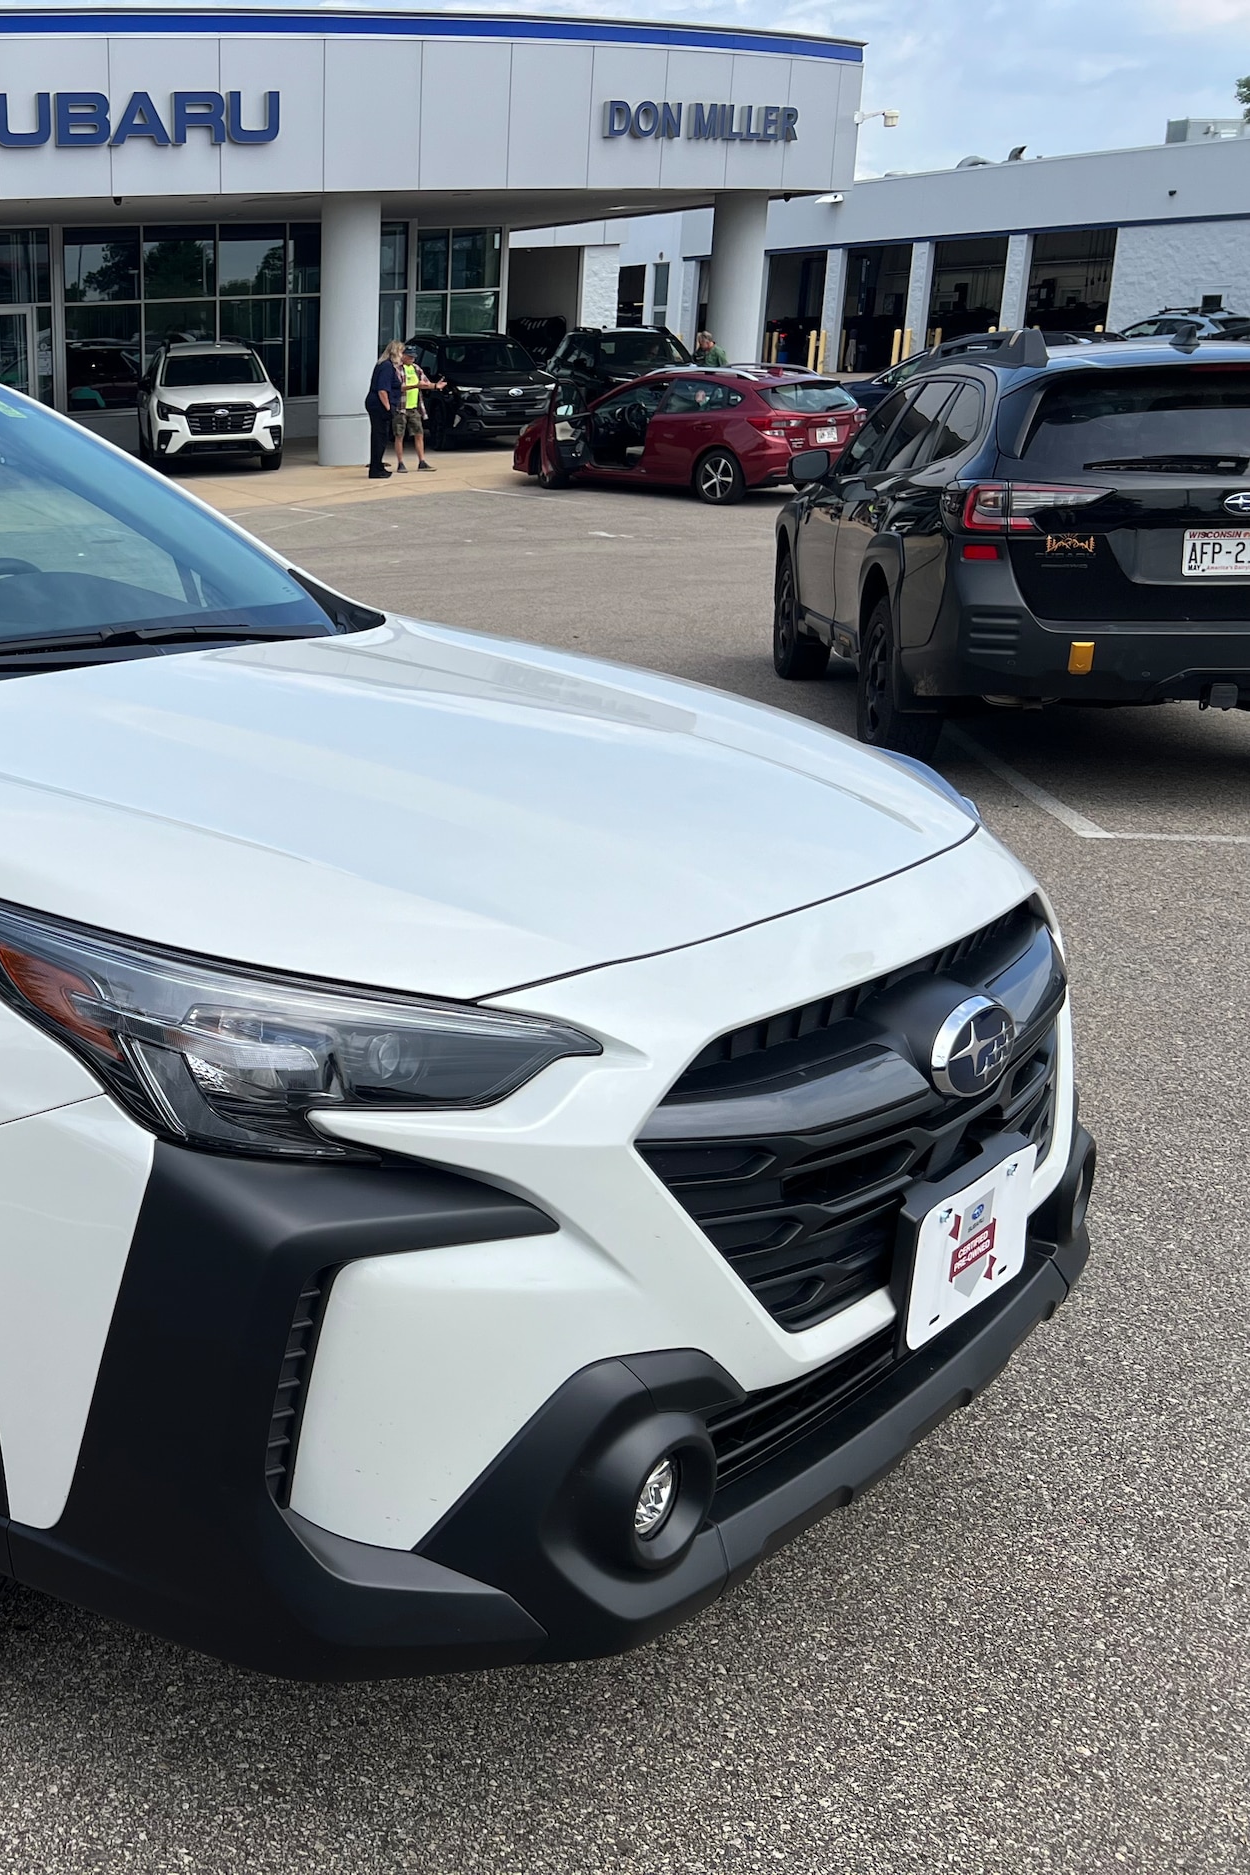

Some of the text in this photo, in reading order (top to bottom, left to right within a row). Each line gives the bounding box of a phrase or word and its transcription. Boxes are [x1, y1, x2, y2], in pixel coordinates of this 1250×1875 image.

[603, 100, 799, 142] DON MILLER
[1188, 531, 1242, 539] WISCONSIN
[1188, 541, 1250, 564] AFP-2
[953, 1239, 991, 1272] PRE-OWNED
[958, 1230, 989, 1258] CERTIFIED
